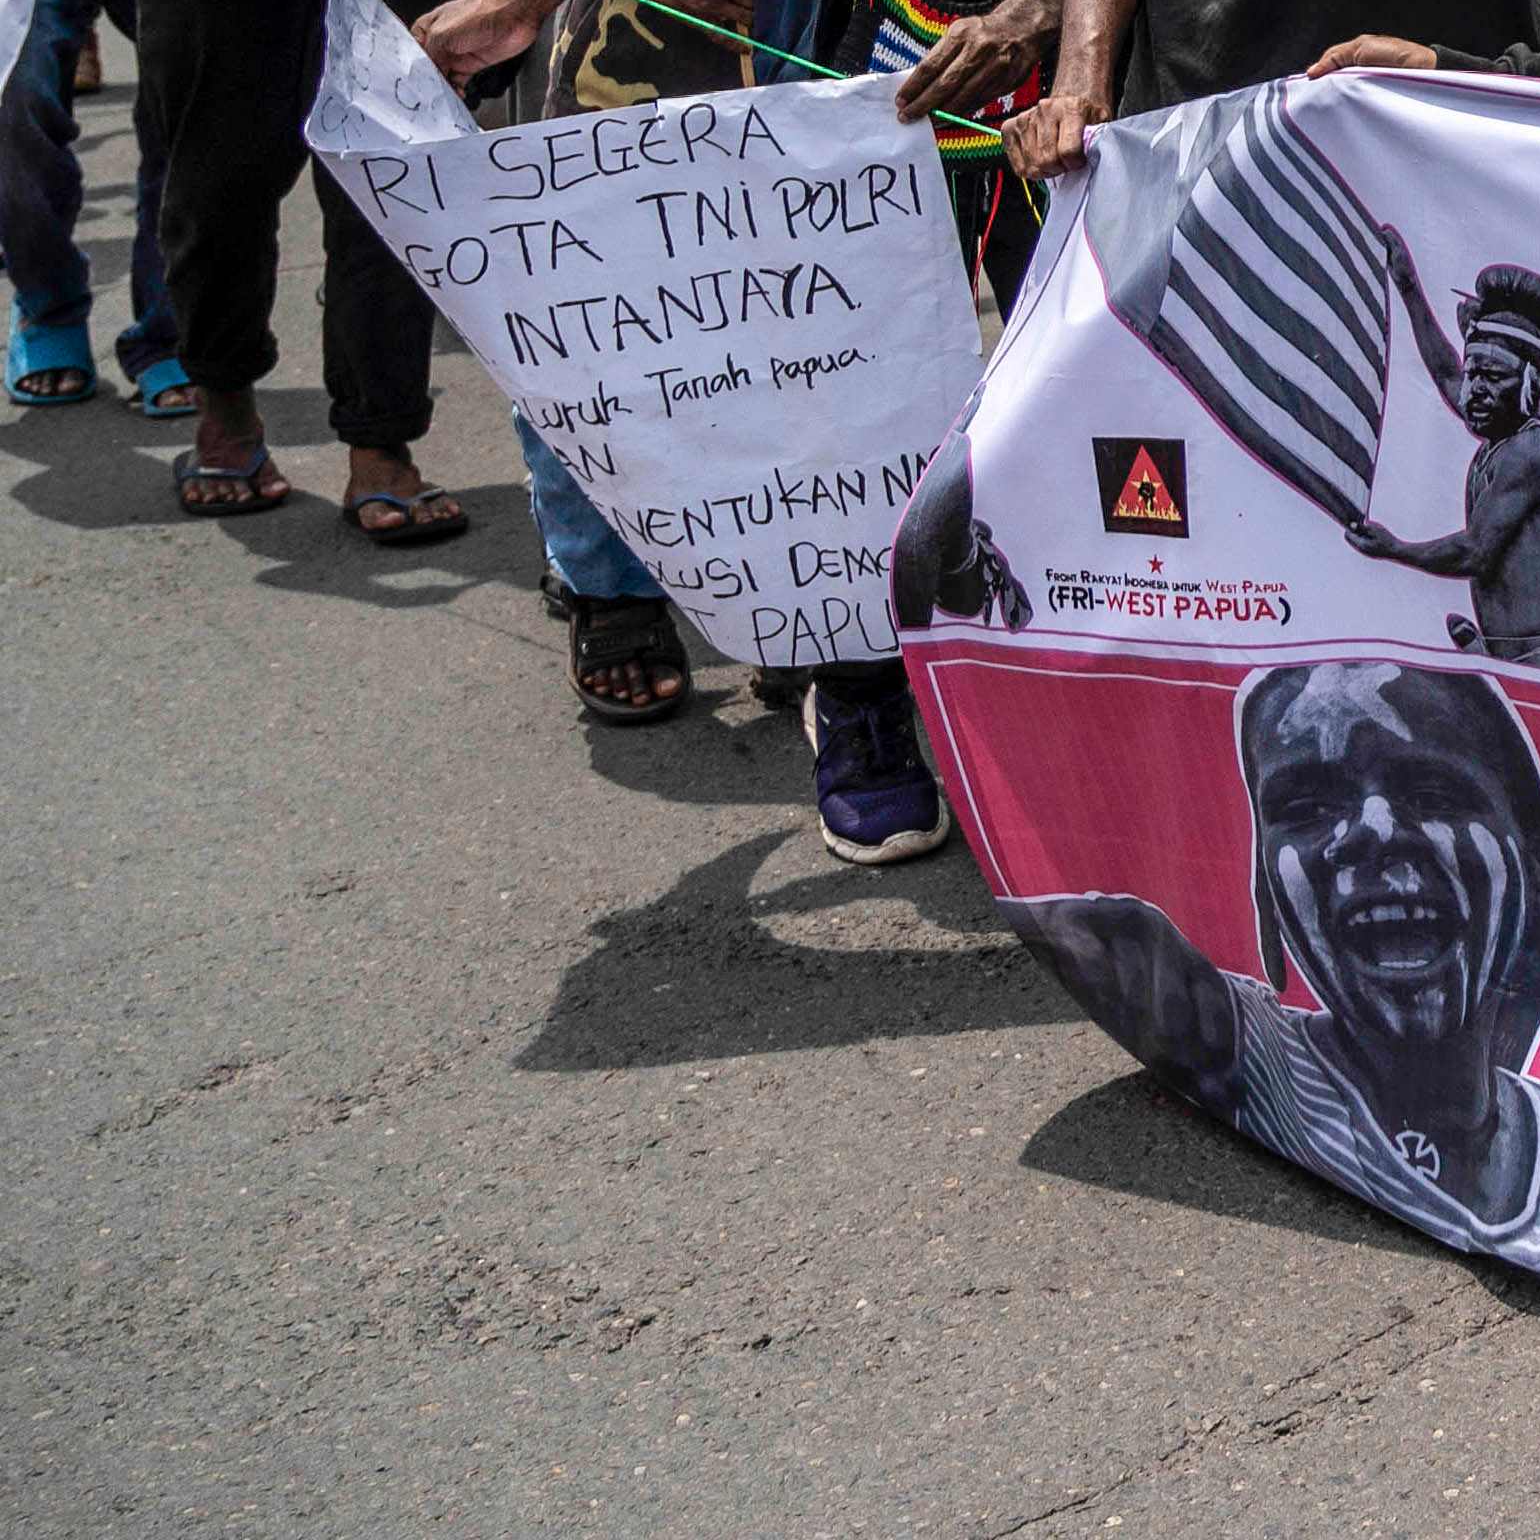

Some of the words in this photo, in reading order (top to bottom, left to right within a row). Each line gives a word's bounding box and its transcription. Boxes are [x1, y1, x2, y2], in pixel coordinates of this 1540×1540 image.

[487, 101, 787, 202] SEGERA
[404, 217, 604, 289] GOTA
[771, 162, 923, 239] POLRI
[642, 353, 752, 419] Tanah
[598, 467, 867, 550] NENTUKAN
[750, 596, 900, 668] PAPU
[1048, 584, 1168, 619] (FRI-WEST
[1173, 595, 1292, 627] PAPUA)
